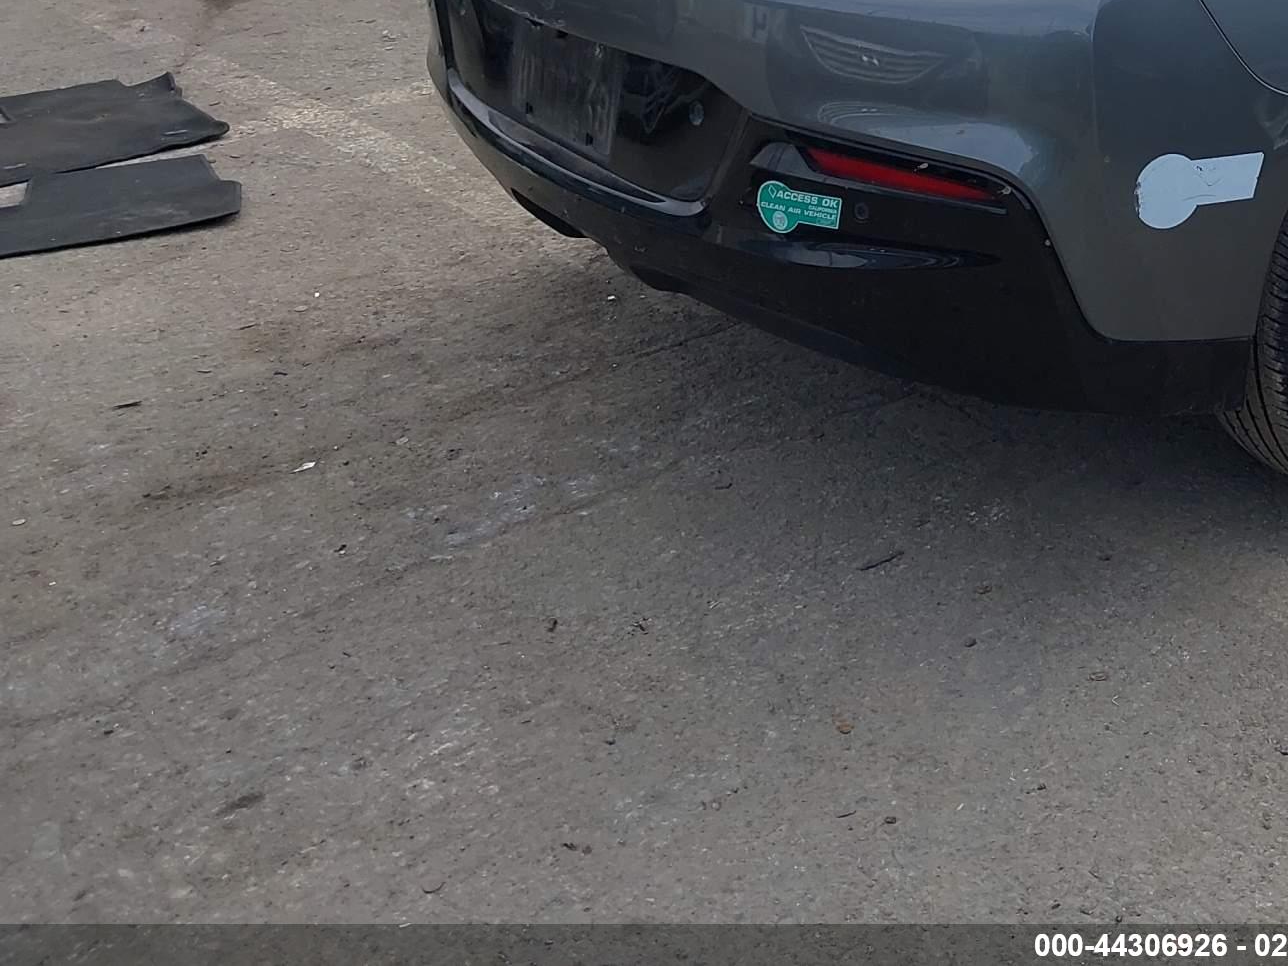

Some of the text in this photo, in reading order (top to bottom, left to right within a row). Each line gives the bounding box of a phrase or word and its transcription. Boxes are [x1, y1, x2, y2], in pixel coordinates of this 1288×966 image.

[776, 190, 839, 208] ACCESS OK
[760, 201, 837, 221] CLEAN AIR VEHICLE
